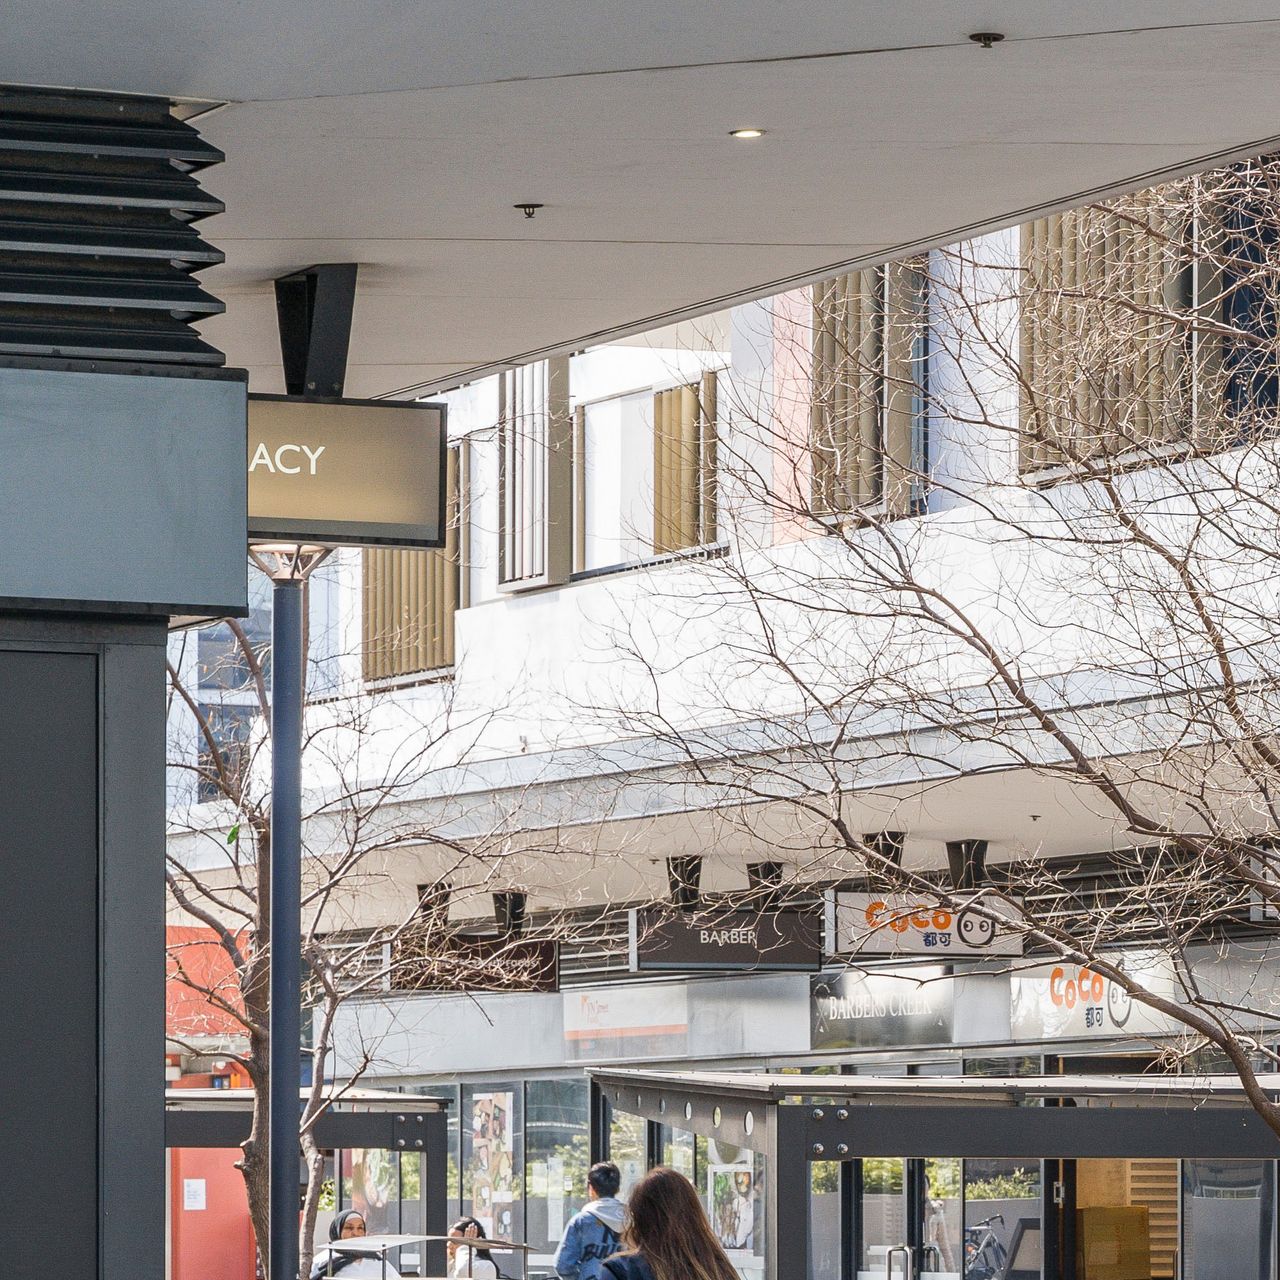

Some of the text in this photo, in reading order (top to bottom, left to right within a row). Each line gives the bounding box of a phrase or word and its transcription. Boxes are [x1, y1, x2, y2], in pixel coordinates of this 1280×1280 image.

[248, 442, 326, 475] ACY
[699, 929, 758, 945] BARBER
[922, 931, 952, 947] 都可
[1050, 966, 1104, 1010] CoCo
[828, 991, 932, 1020] BARBERS CREEK
[1085, 1006, 1104, 1028] 都可
